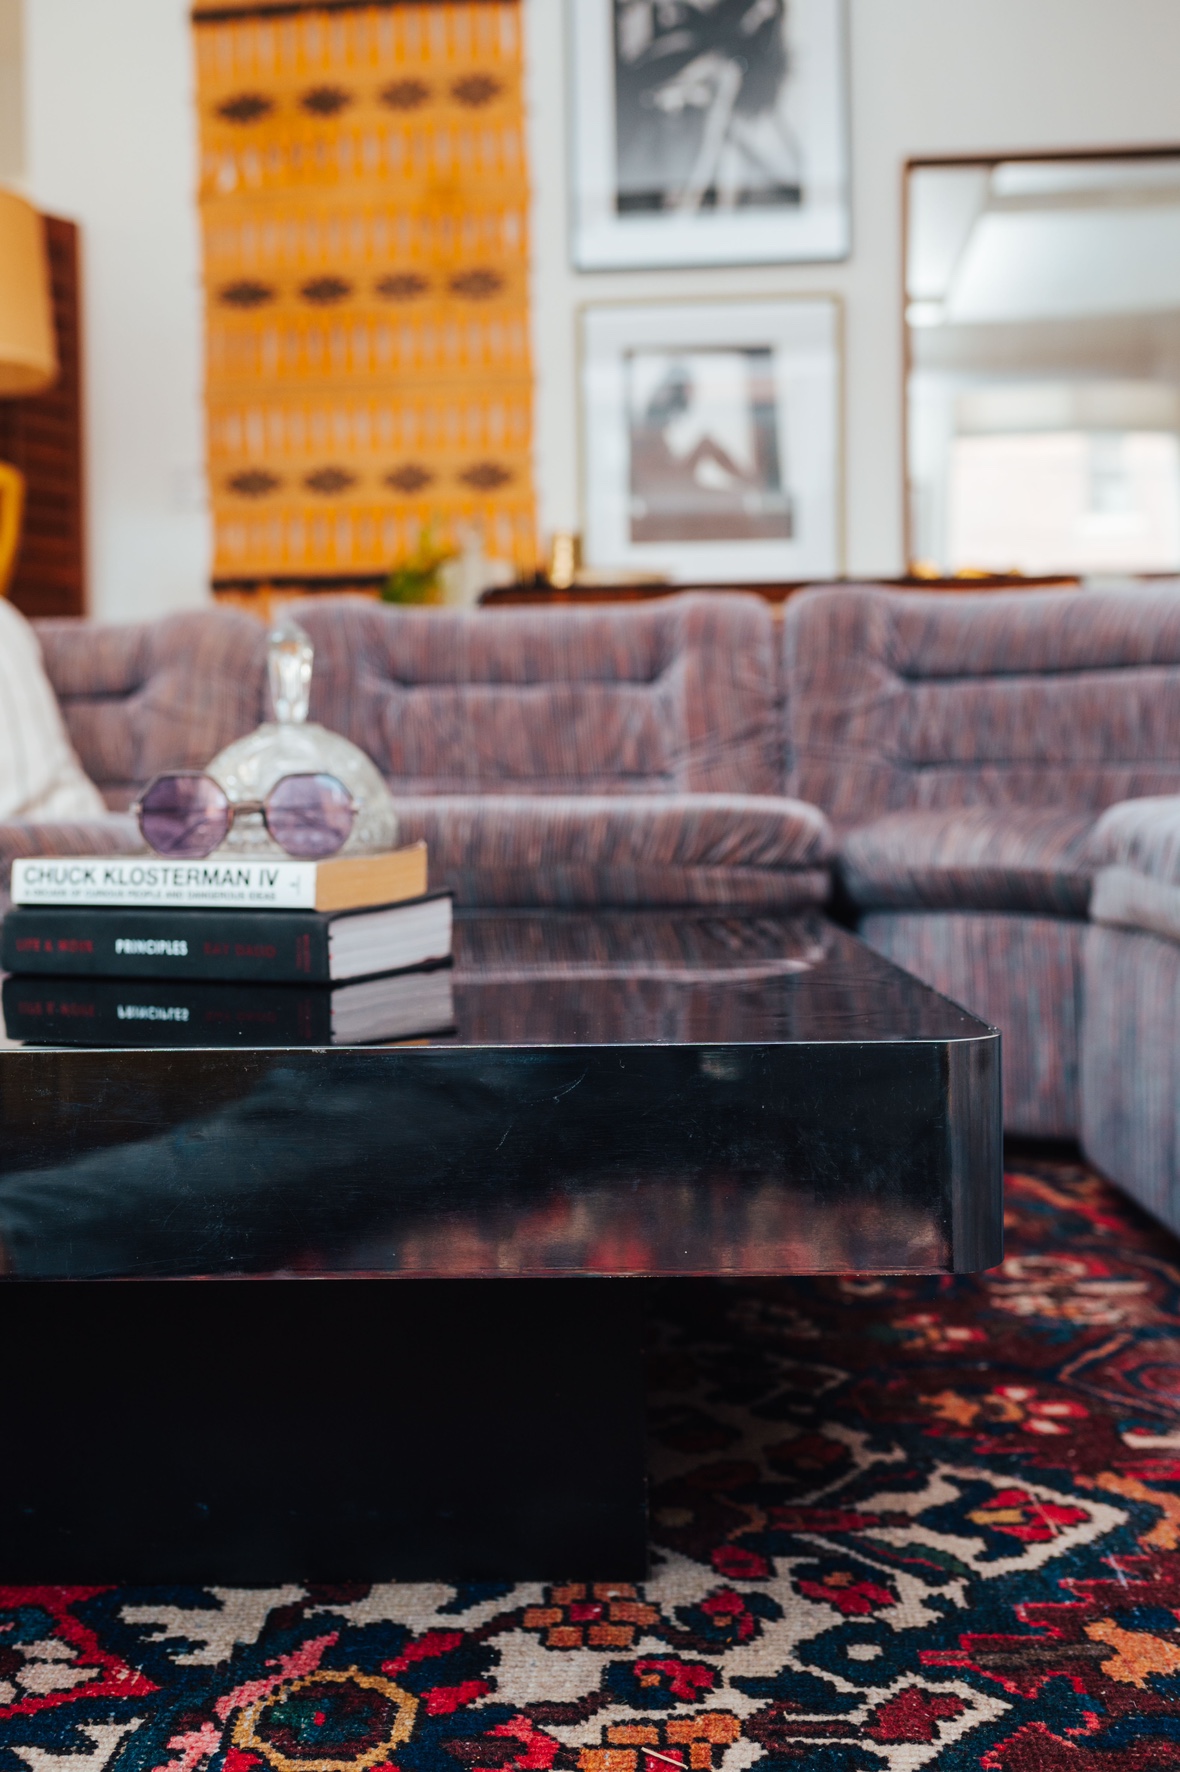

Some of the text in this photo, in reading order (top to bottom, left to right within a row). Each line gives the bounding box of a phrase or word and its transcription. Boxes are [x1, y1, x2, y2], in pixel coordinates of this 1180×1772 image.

[24, 866, 280, 888] CHUCK KLOSTERMAN IV
[114, 938, 188, 957] PRINCIPLES
